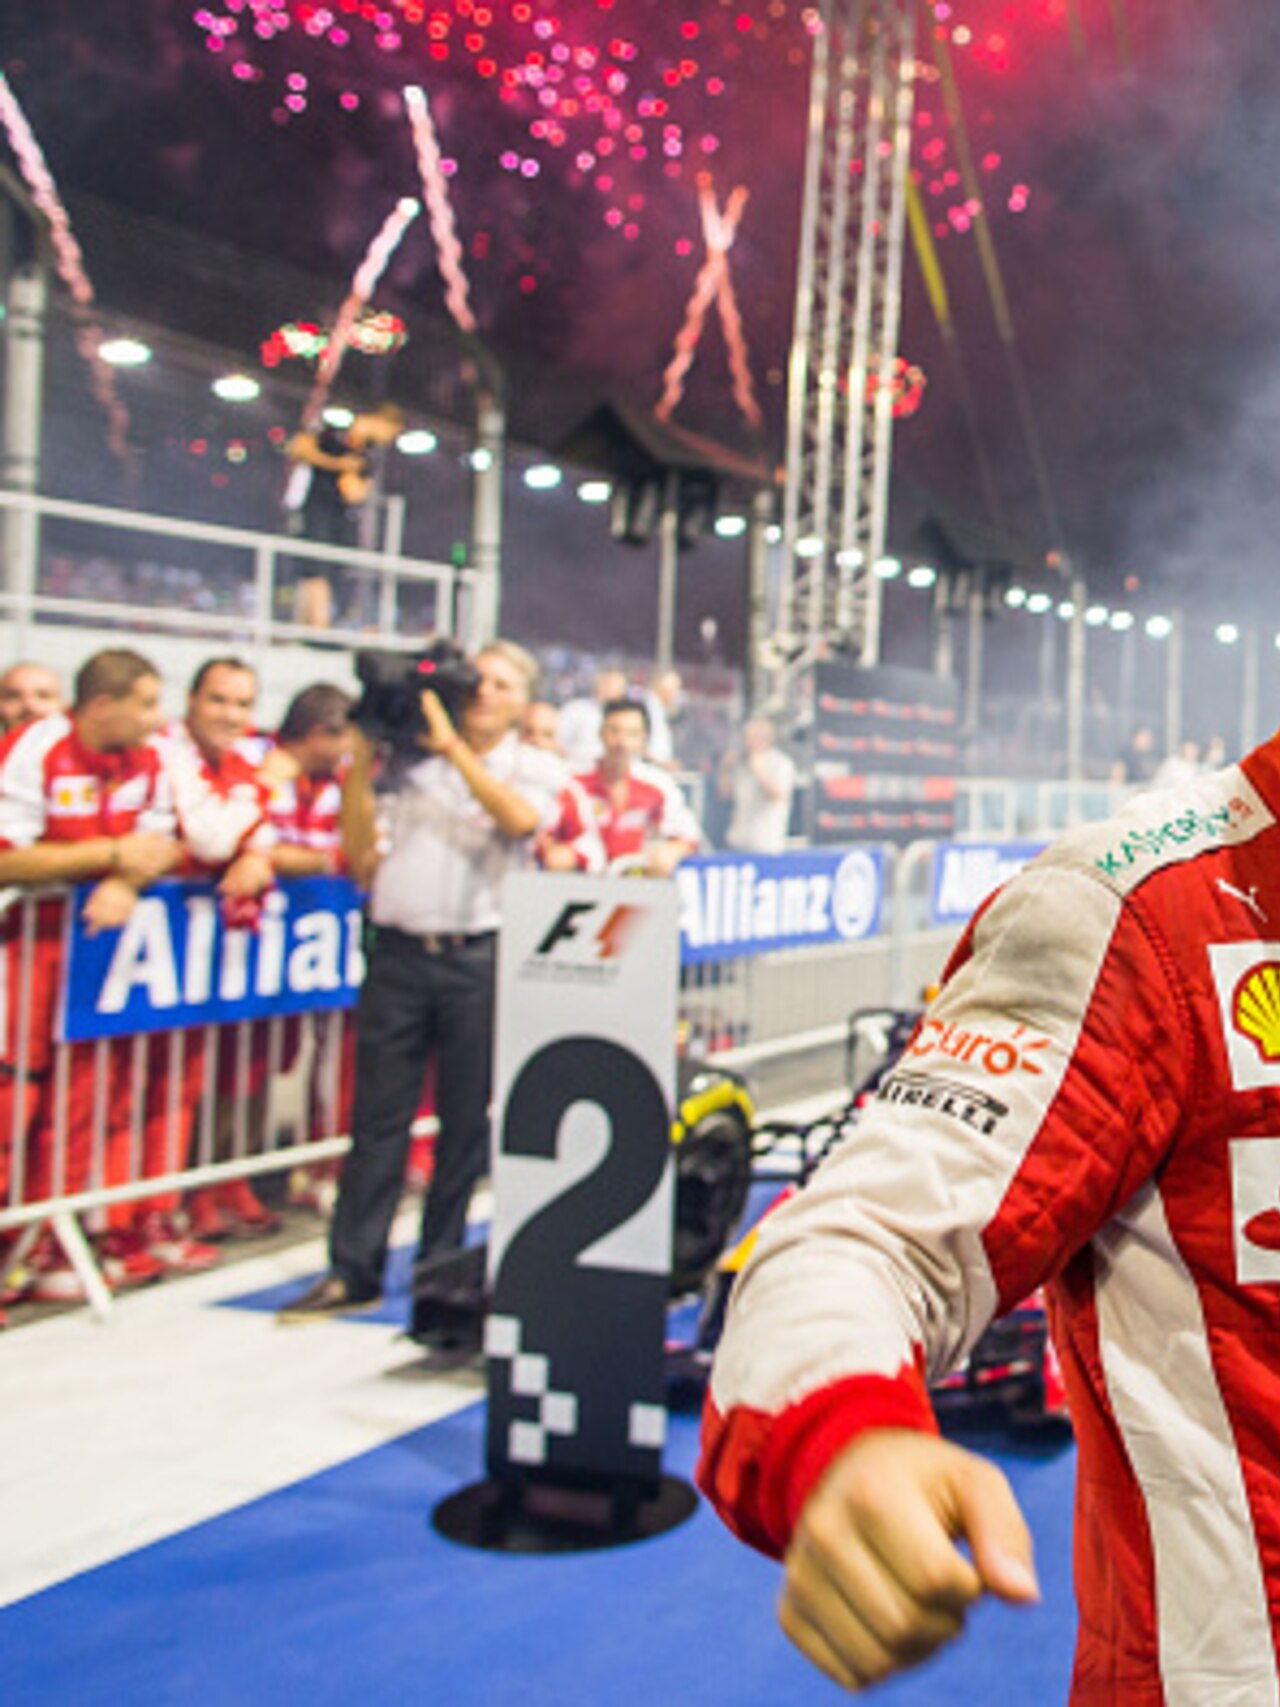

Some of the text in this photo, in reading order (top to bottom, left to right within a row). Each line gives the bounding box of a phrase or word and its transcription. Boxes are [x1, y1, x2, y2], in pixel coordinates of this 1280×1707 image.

[533, 900, 652, 960] F1
[676, 862, 832, 948] Allianz
[496, 1034, 674, 1300] 2
